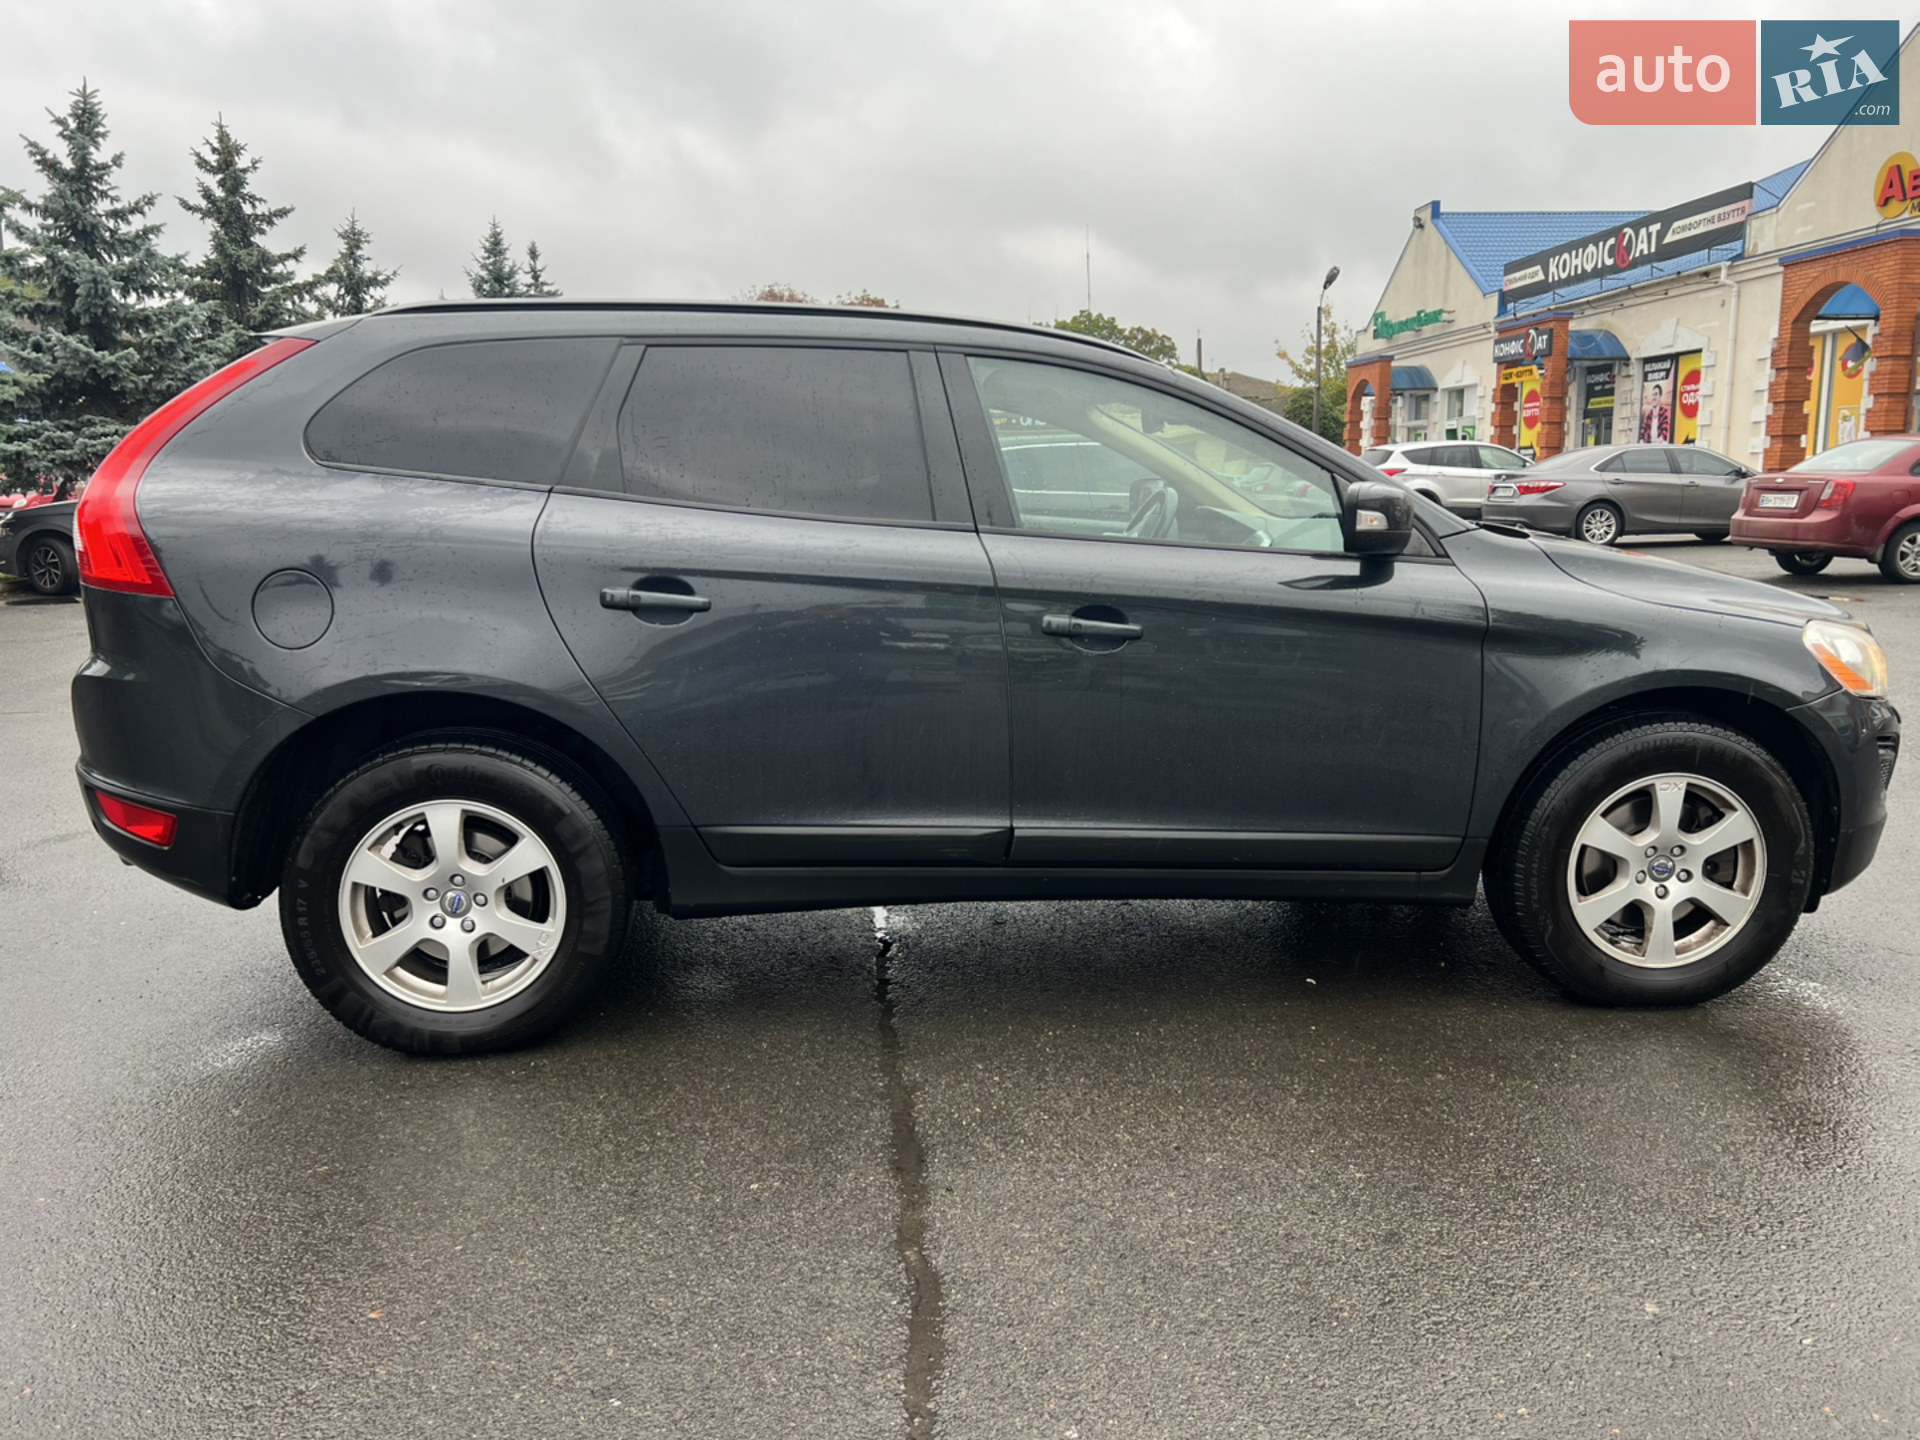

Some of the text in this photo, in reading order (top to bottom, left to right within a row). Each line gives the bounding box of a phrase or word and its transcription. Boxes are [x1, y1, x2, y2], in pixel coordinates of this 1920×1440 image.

[1671, 206, 1747, 236] КОМФОРТНЕ ВЗУТТЯ
[1548, 222, 1662, 283] КОНФІСКАТ
[1494, 328, 1548, 360] КОНФІСКАТ
